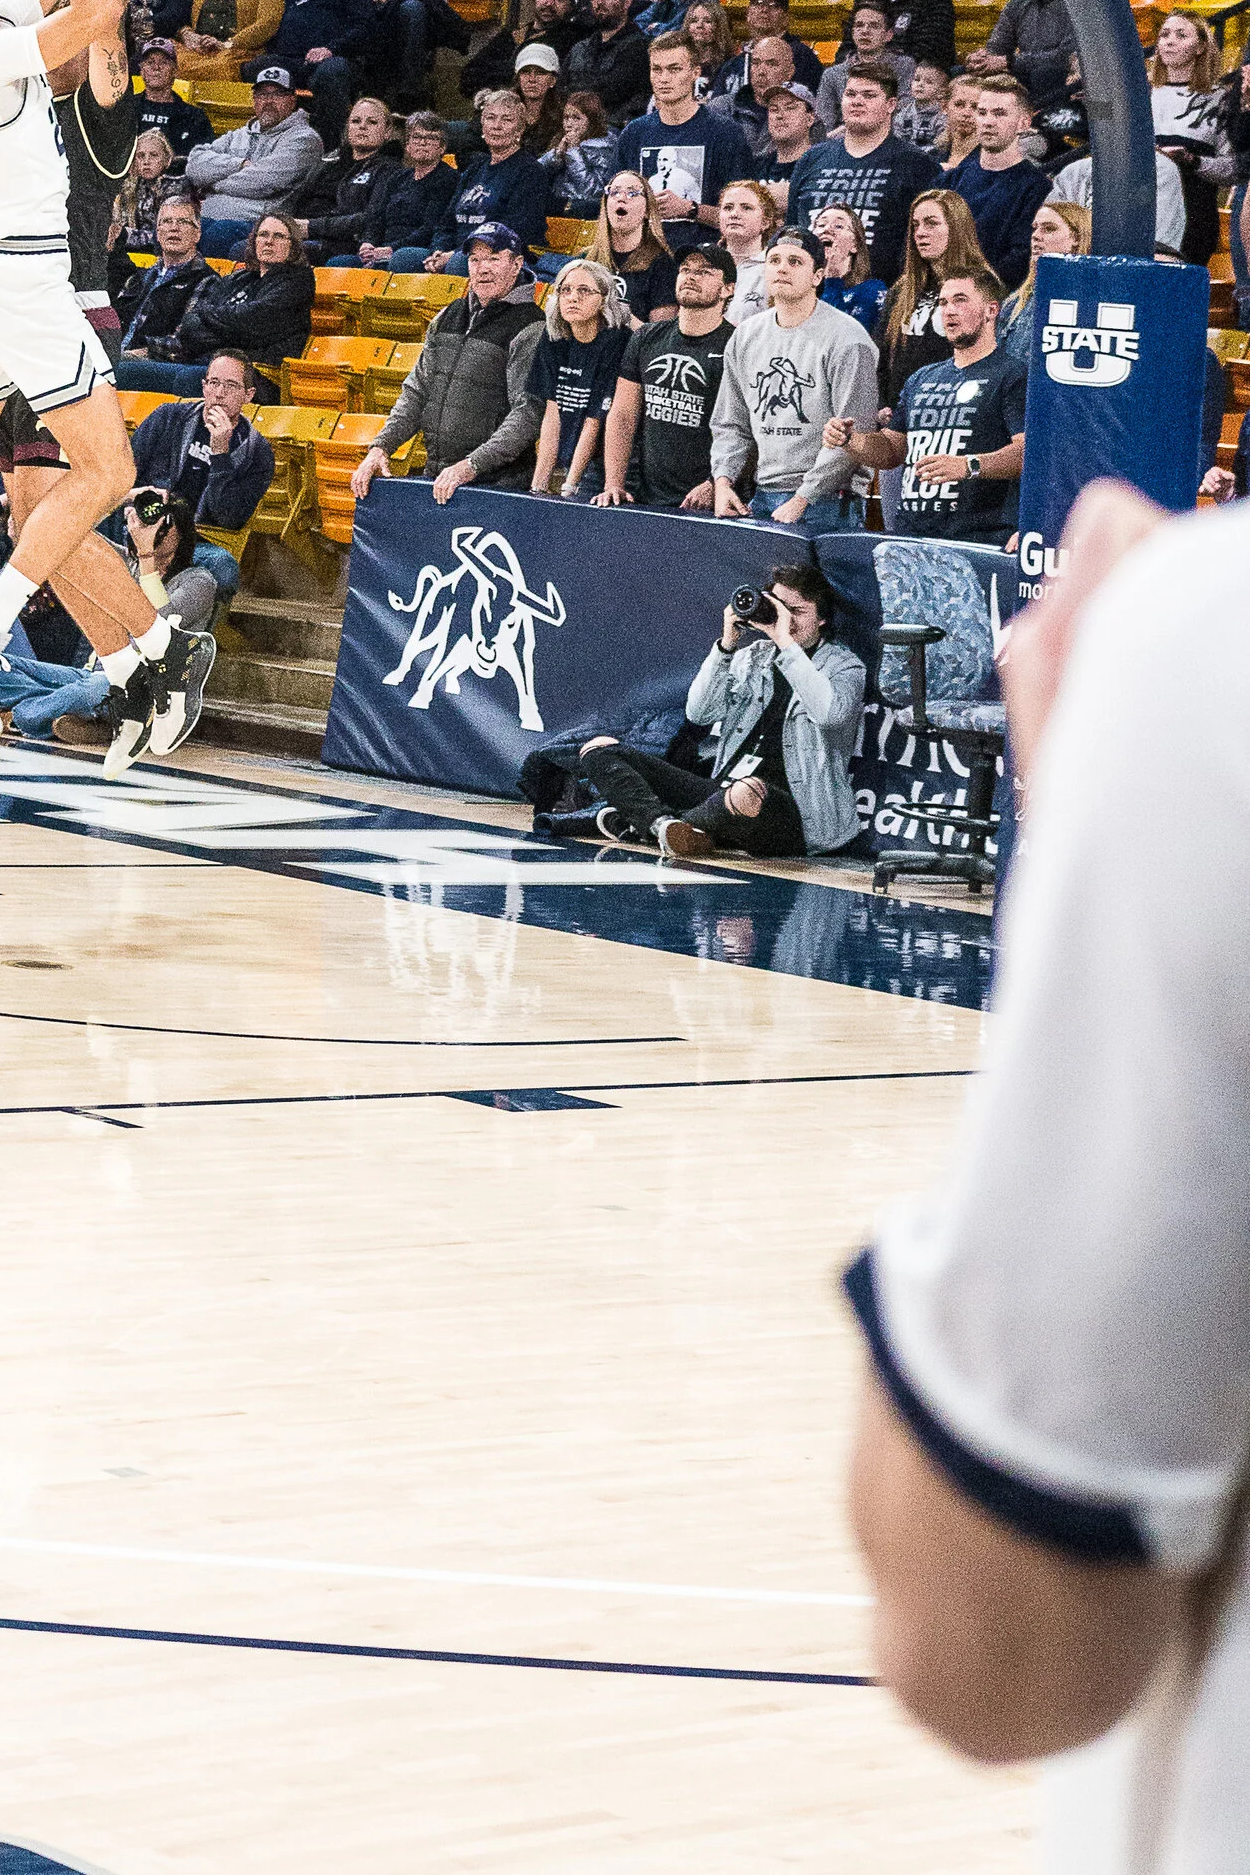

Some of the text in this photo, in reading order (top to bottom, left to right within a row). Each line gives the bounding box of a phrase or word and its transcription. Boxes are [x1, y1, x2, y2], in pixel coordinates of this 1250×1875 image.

[1042, 325, 1140, 361] STATE
[672, 390, 705, 407] STATE
[905, 428, 974, 466] TRUE
